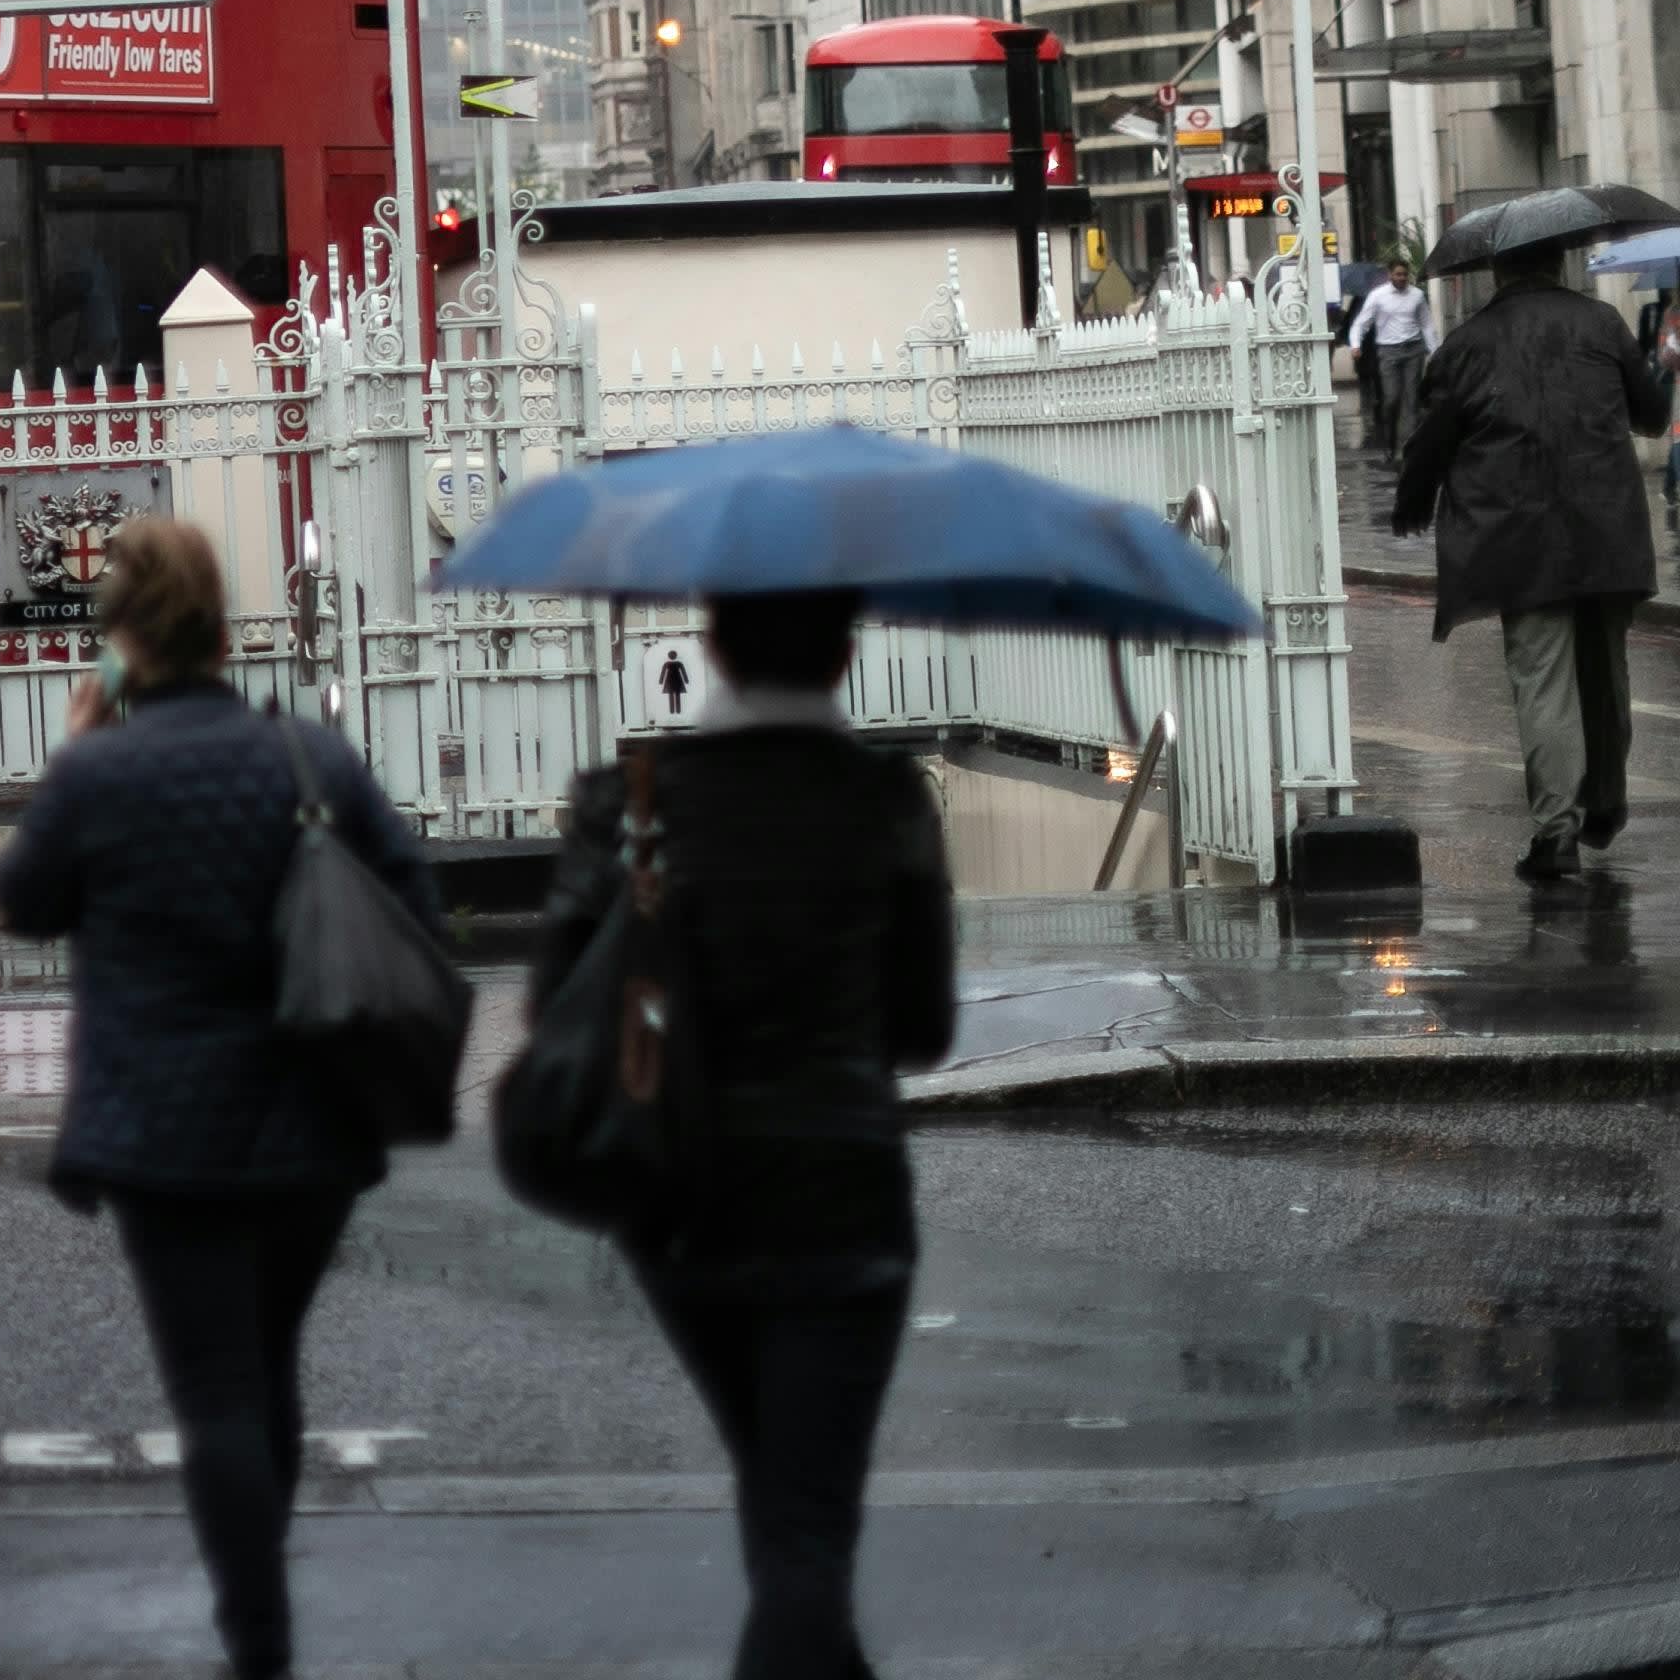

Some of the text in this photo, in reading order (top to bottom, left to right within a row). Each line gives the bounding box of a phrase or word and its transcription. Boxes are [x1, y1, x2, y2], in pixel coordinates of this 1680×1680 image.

[48, 33, 202, 79] Friendly low fares
[24, 605, 57, 619] CITY
[61, 604, 81, 617] OF
